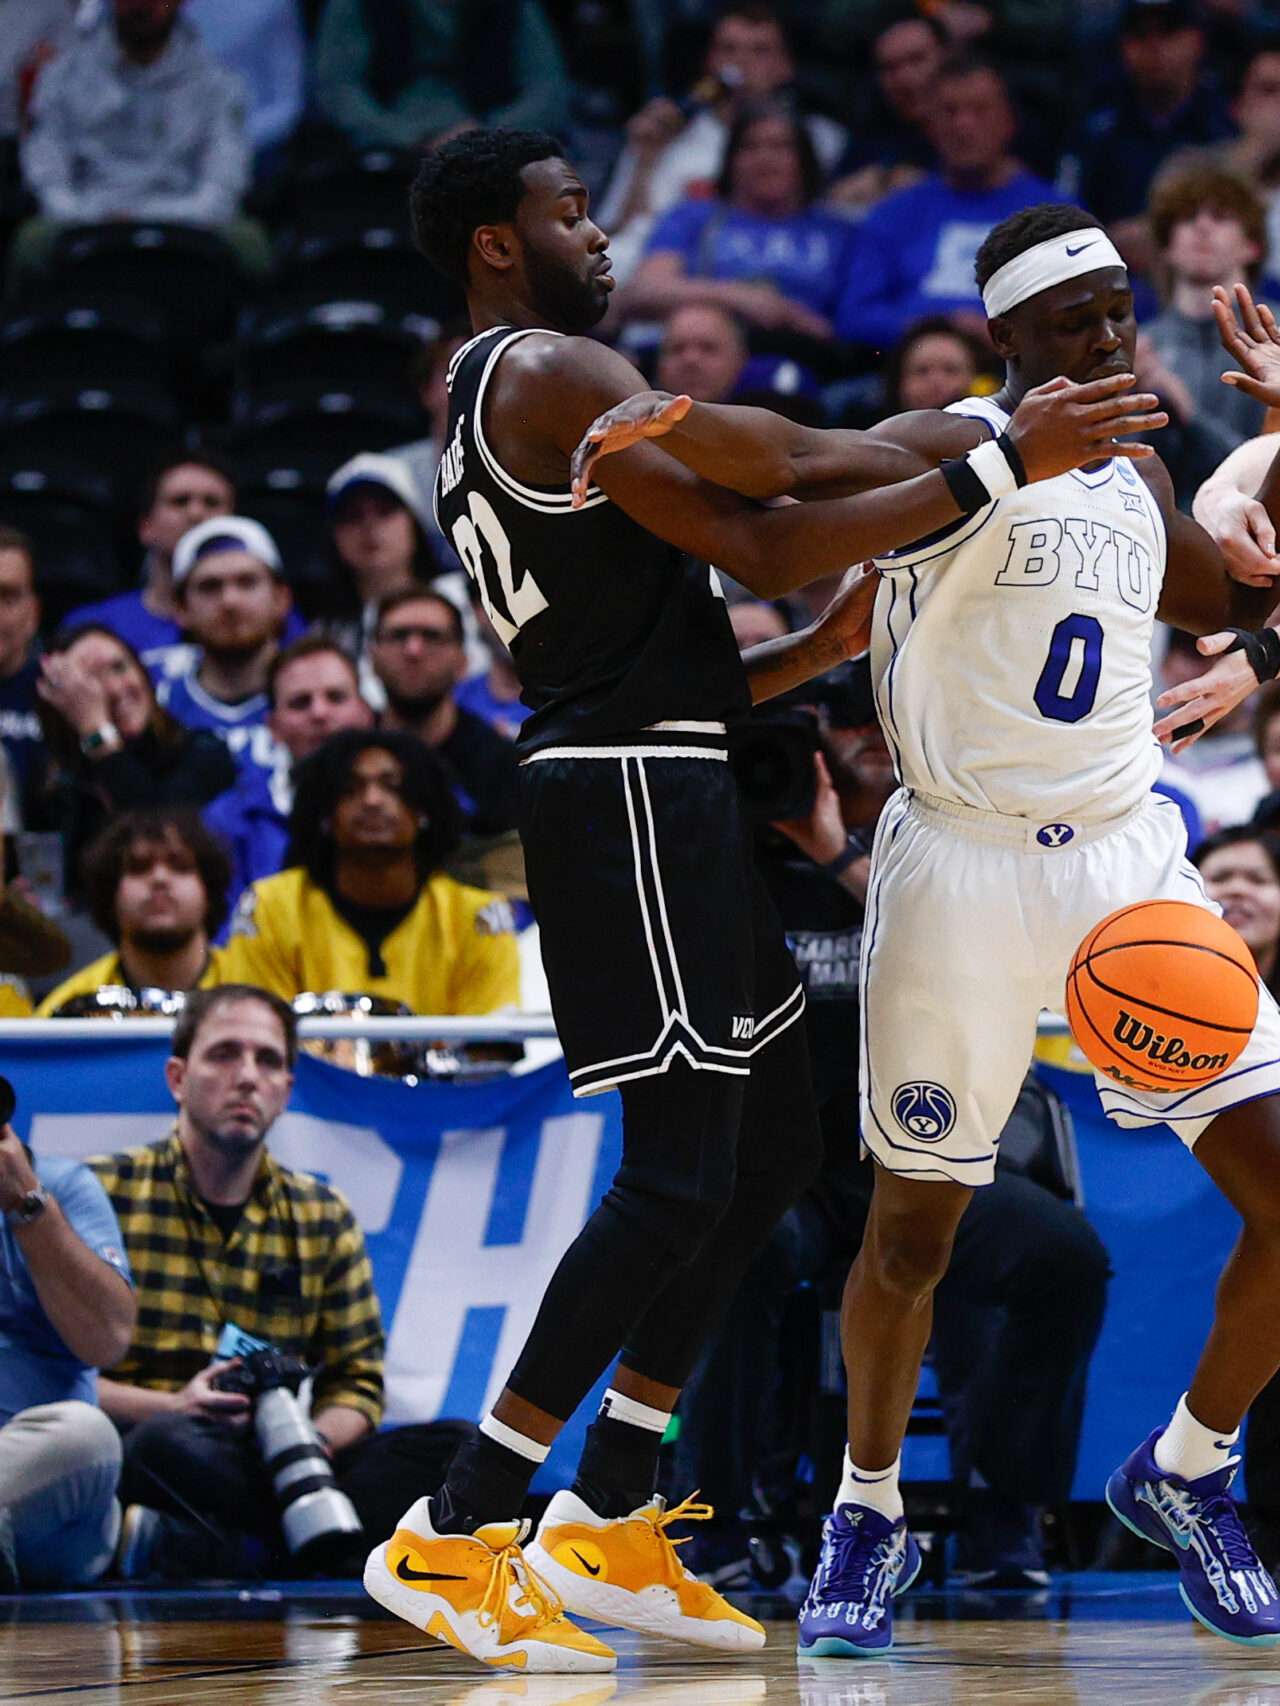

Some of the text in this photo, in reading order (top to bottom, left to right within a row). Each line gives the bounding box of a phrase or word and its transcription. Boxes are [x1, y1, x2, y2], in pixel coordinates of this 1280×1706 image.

[994, 518, 1152, 613] BYU
[1033, 612, 1104, 723] 0
[1043, 826, 1069, 846] Y
[1113, 1009, 1229, 1070] Wilson
